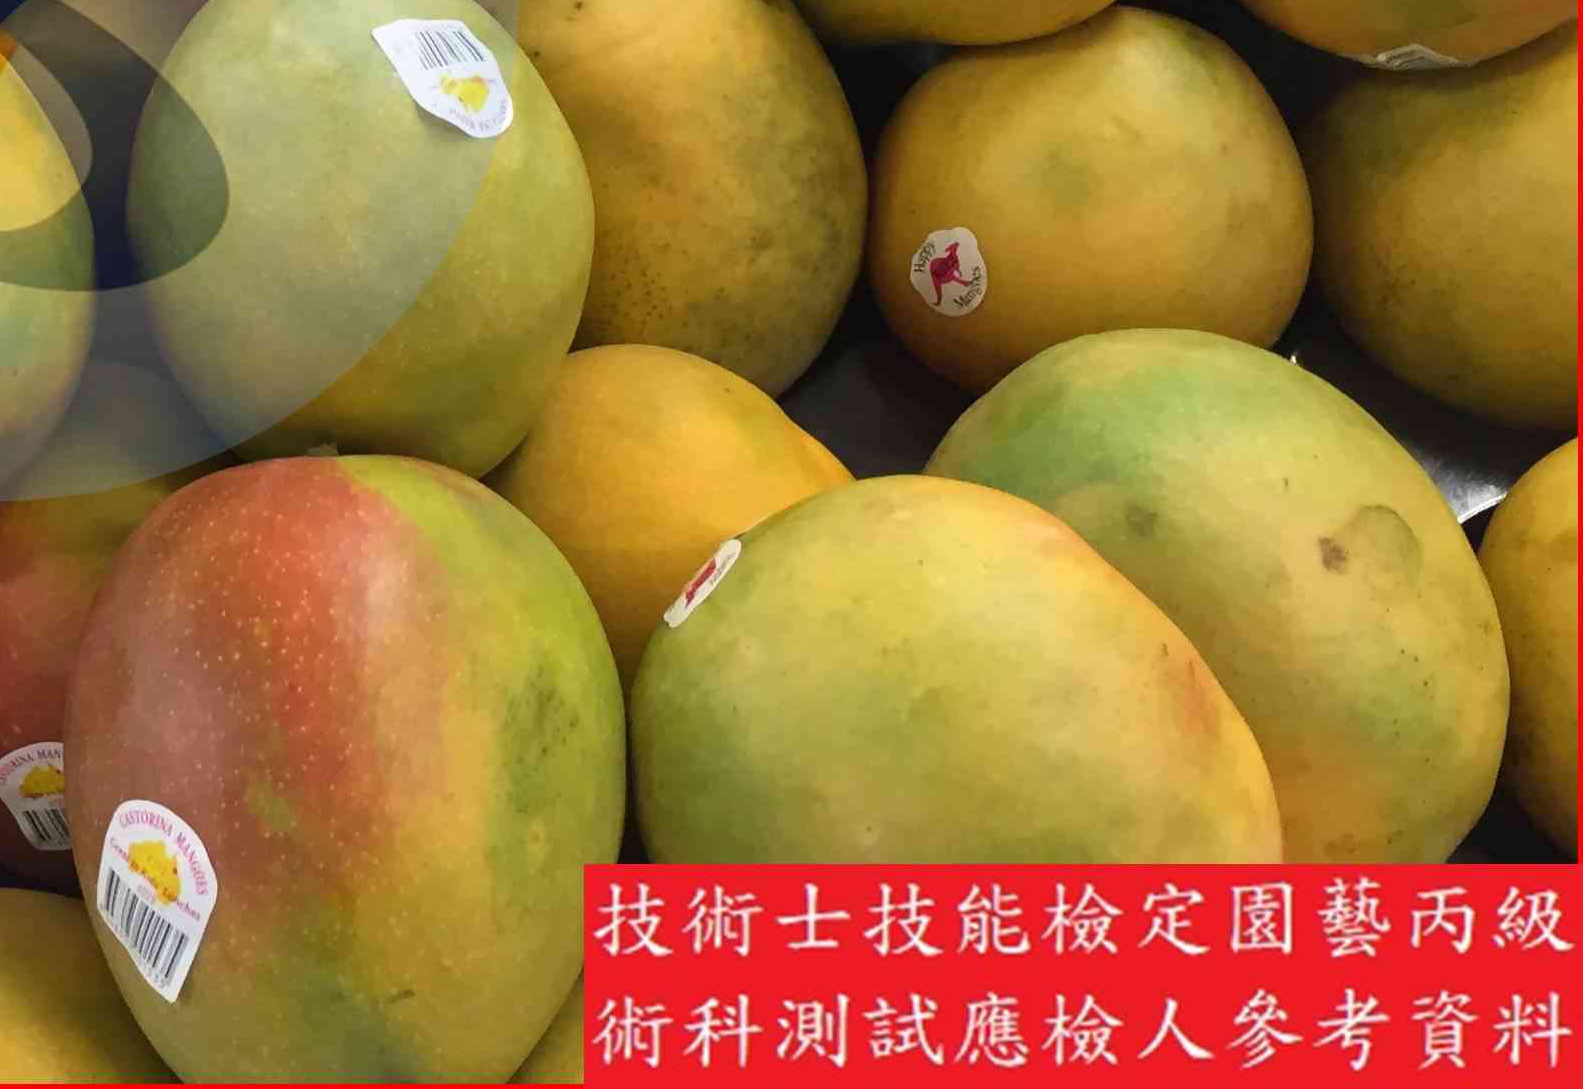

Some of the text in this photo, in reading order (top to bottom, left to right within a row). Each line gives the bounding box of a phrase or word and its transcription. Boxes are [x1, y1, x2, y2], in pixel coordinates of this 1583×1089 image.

[913, 240, 936, 273] Happy
[952, 265, 983, 310] Mangoes
[36, 748, 63, 760] MAN
[119, 809, 173, 838] CASTORINA
[176, 831, 209, 896] MANGOES
